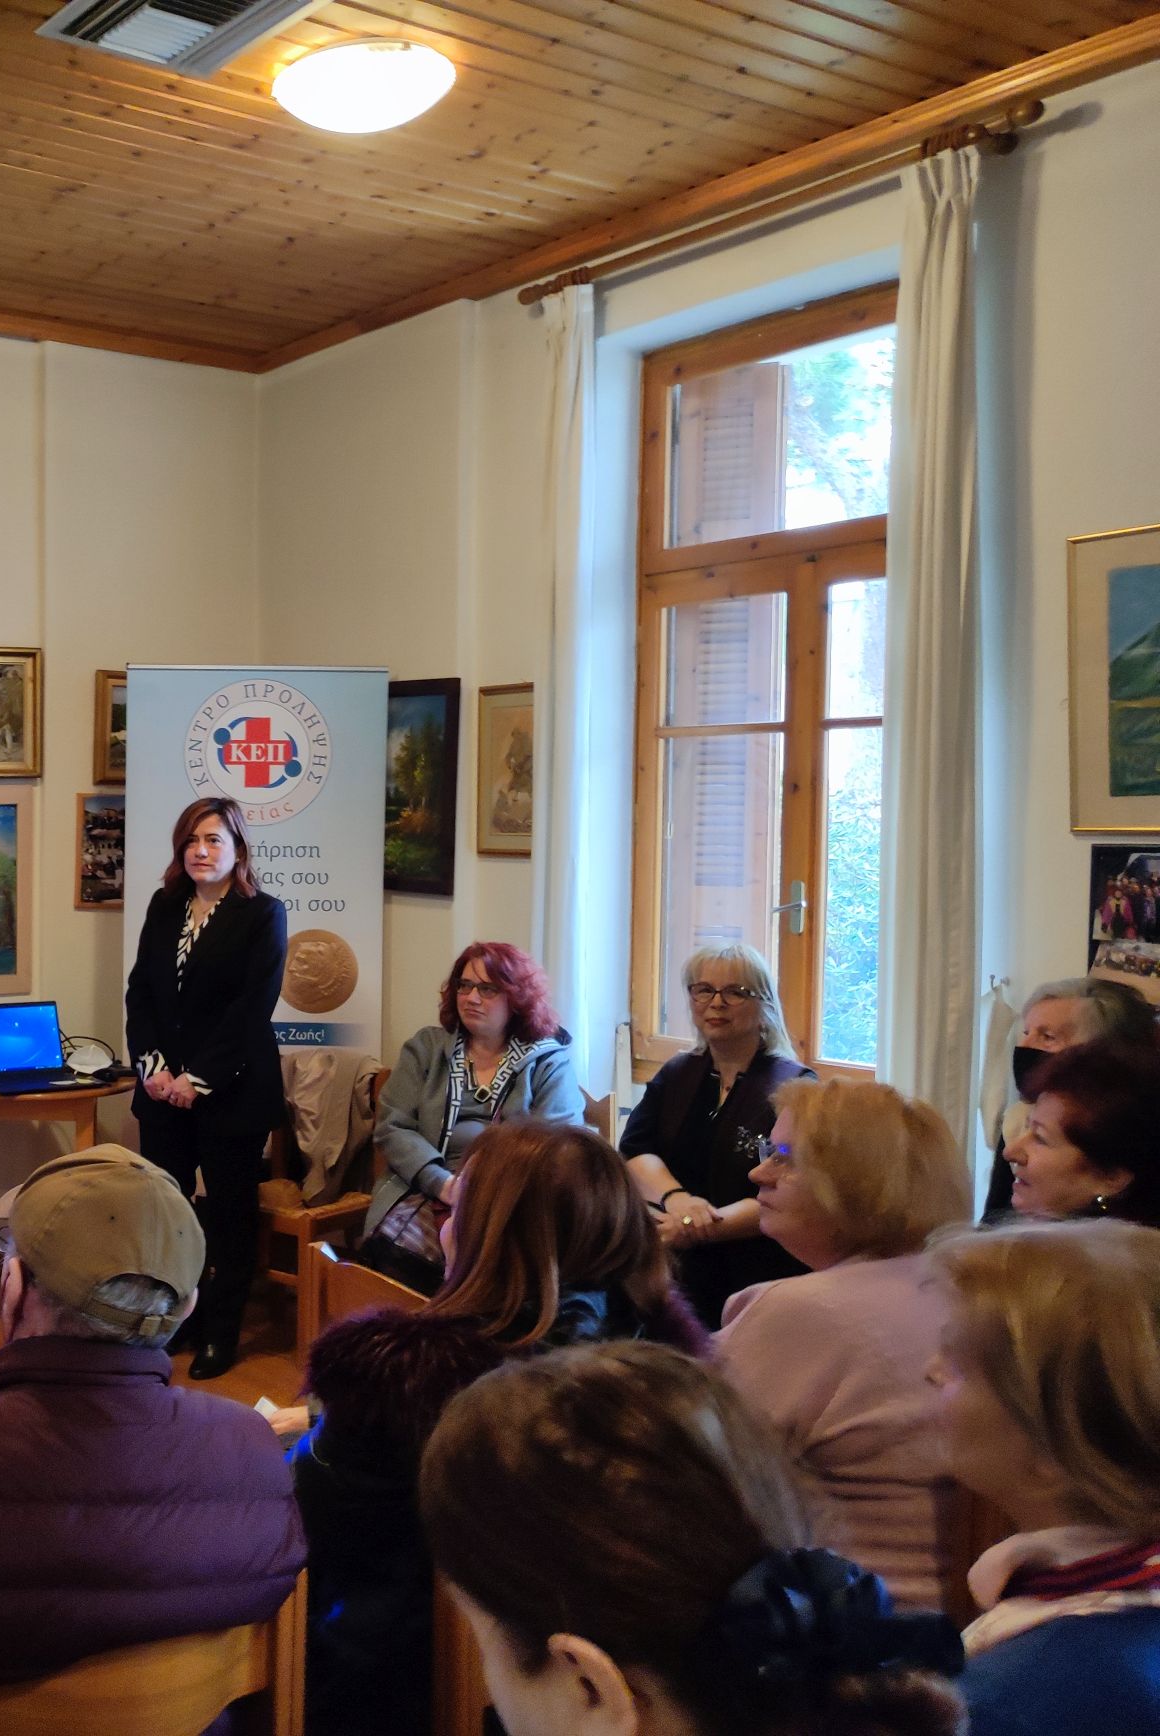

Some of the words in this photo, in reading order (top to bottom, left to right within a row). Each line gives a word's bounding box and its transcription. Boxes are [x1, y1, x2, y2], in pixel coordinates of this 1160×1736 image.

[188, 694, 230, 787] ΚΕΝΤΡΟ
[244, 683, 328, 785] ΠΡΟΛΗΨΗΣ
[230, 743, 286, 763] ΚΕΠ
[291, 871, 329, 885] σου
[308, 899, 346, 912] σου
[288, 1028, 325, 1043] Ζωής!
